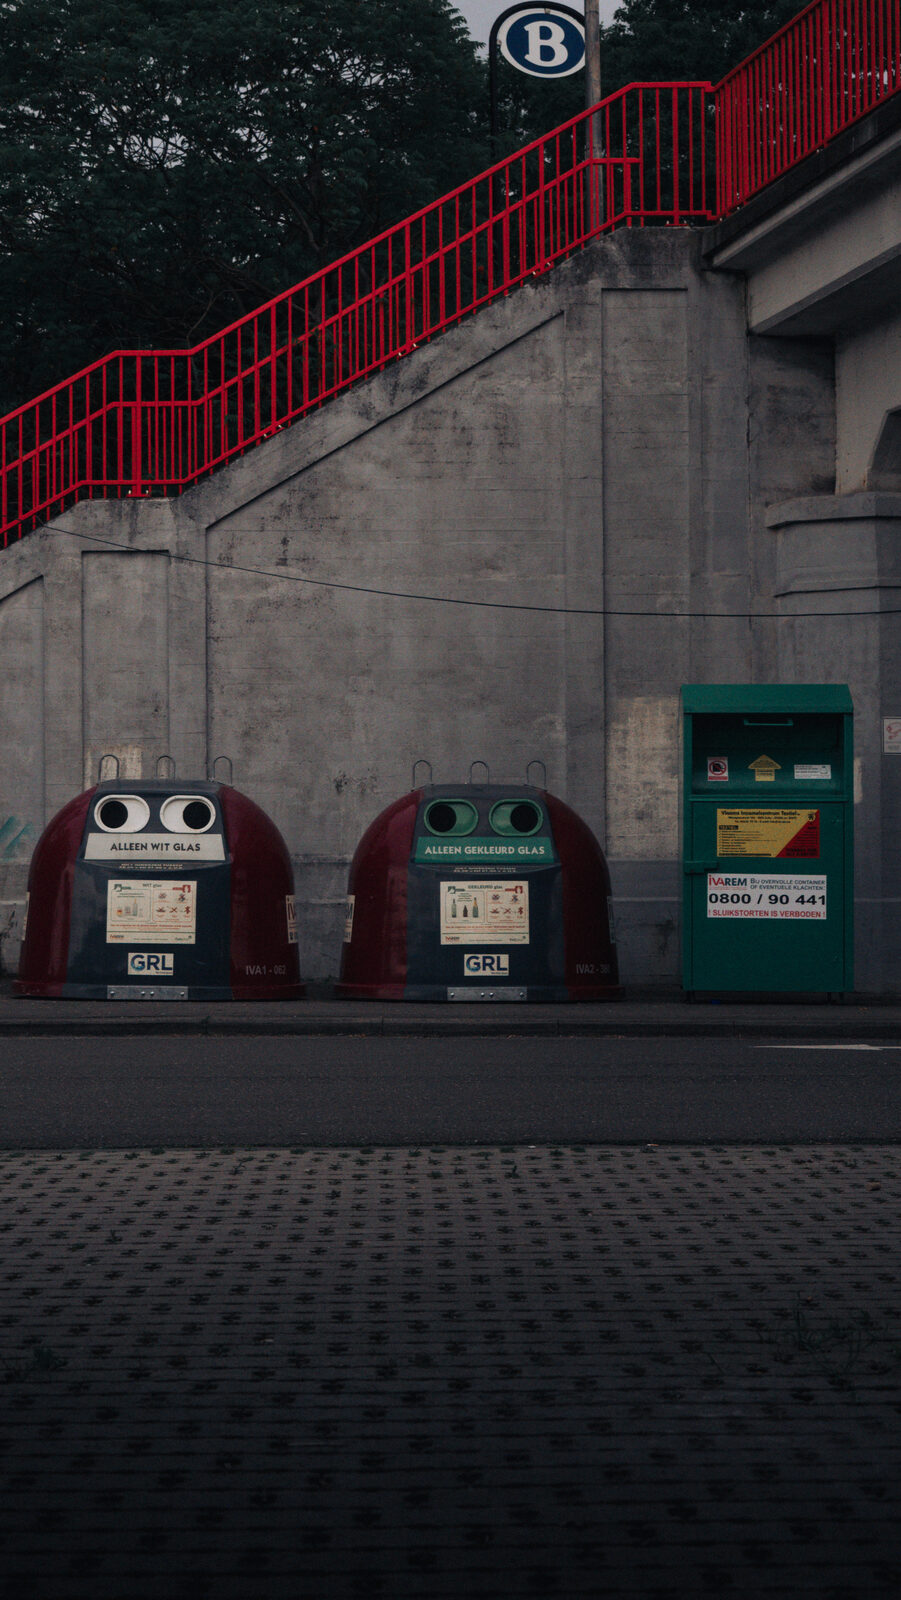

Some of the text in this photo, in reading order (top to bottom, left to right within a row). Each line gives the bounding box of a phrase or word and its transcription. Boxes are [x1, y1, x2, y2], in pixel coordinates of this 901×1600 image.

[523, 20, 569, 68] B
[110, 843, 201, 852] ALLEEN WIT GLAS
[424, 846, 545, 855] ALLEEN GEKLEURD GLAS
[708, 893, 825, 906] 0800 / 90 441
[131, 954, 173, 971] GRL
[466, 955, 508, 972] GRL
